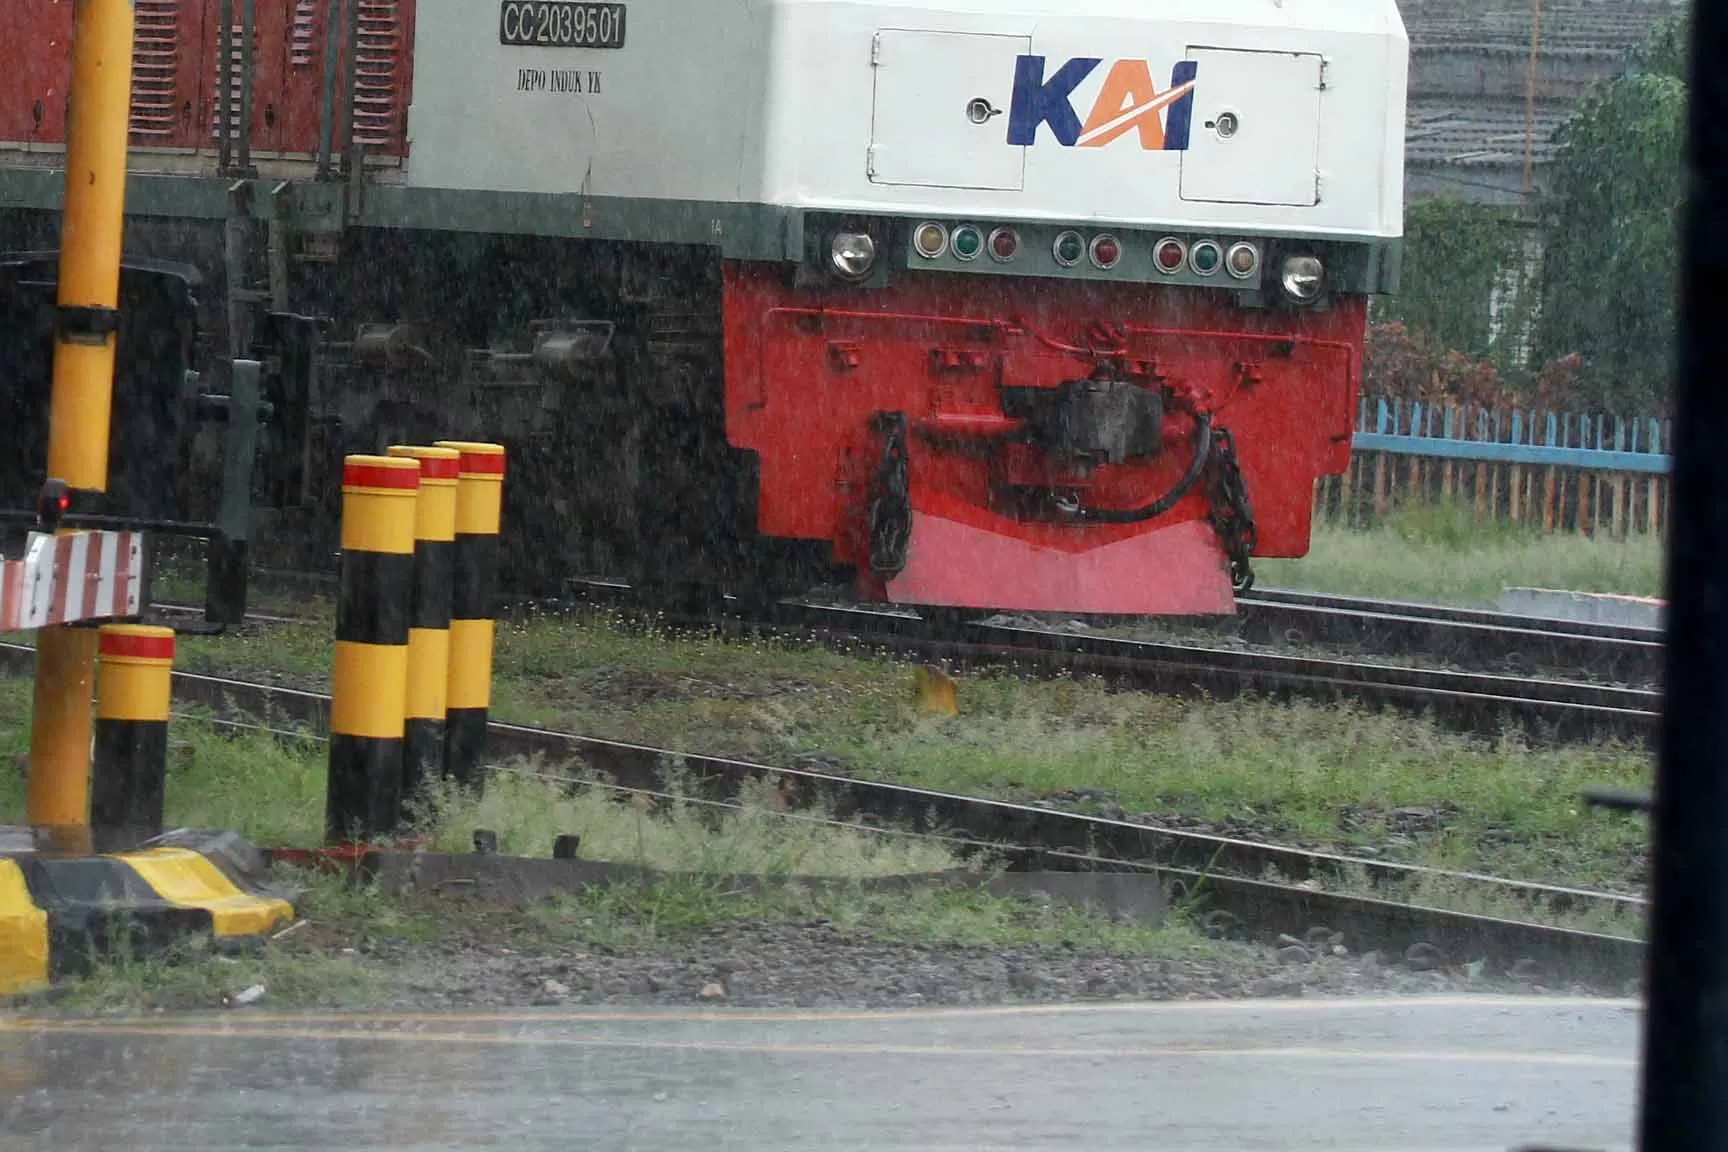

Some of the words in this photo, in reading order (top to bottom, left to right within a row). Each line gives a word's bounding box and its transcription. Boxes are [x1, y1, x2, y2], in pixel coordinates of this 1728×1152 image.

[516, 68, 546, 92] DEPO
[550, 70, 582, 94] INDUK
[1007, 55, 1198, 151] KAI
